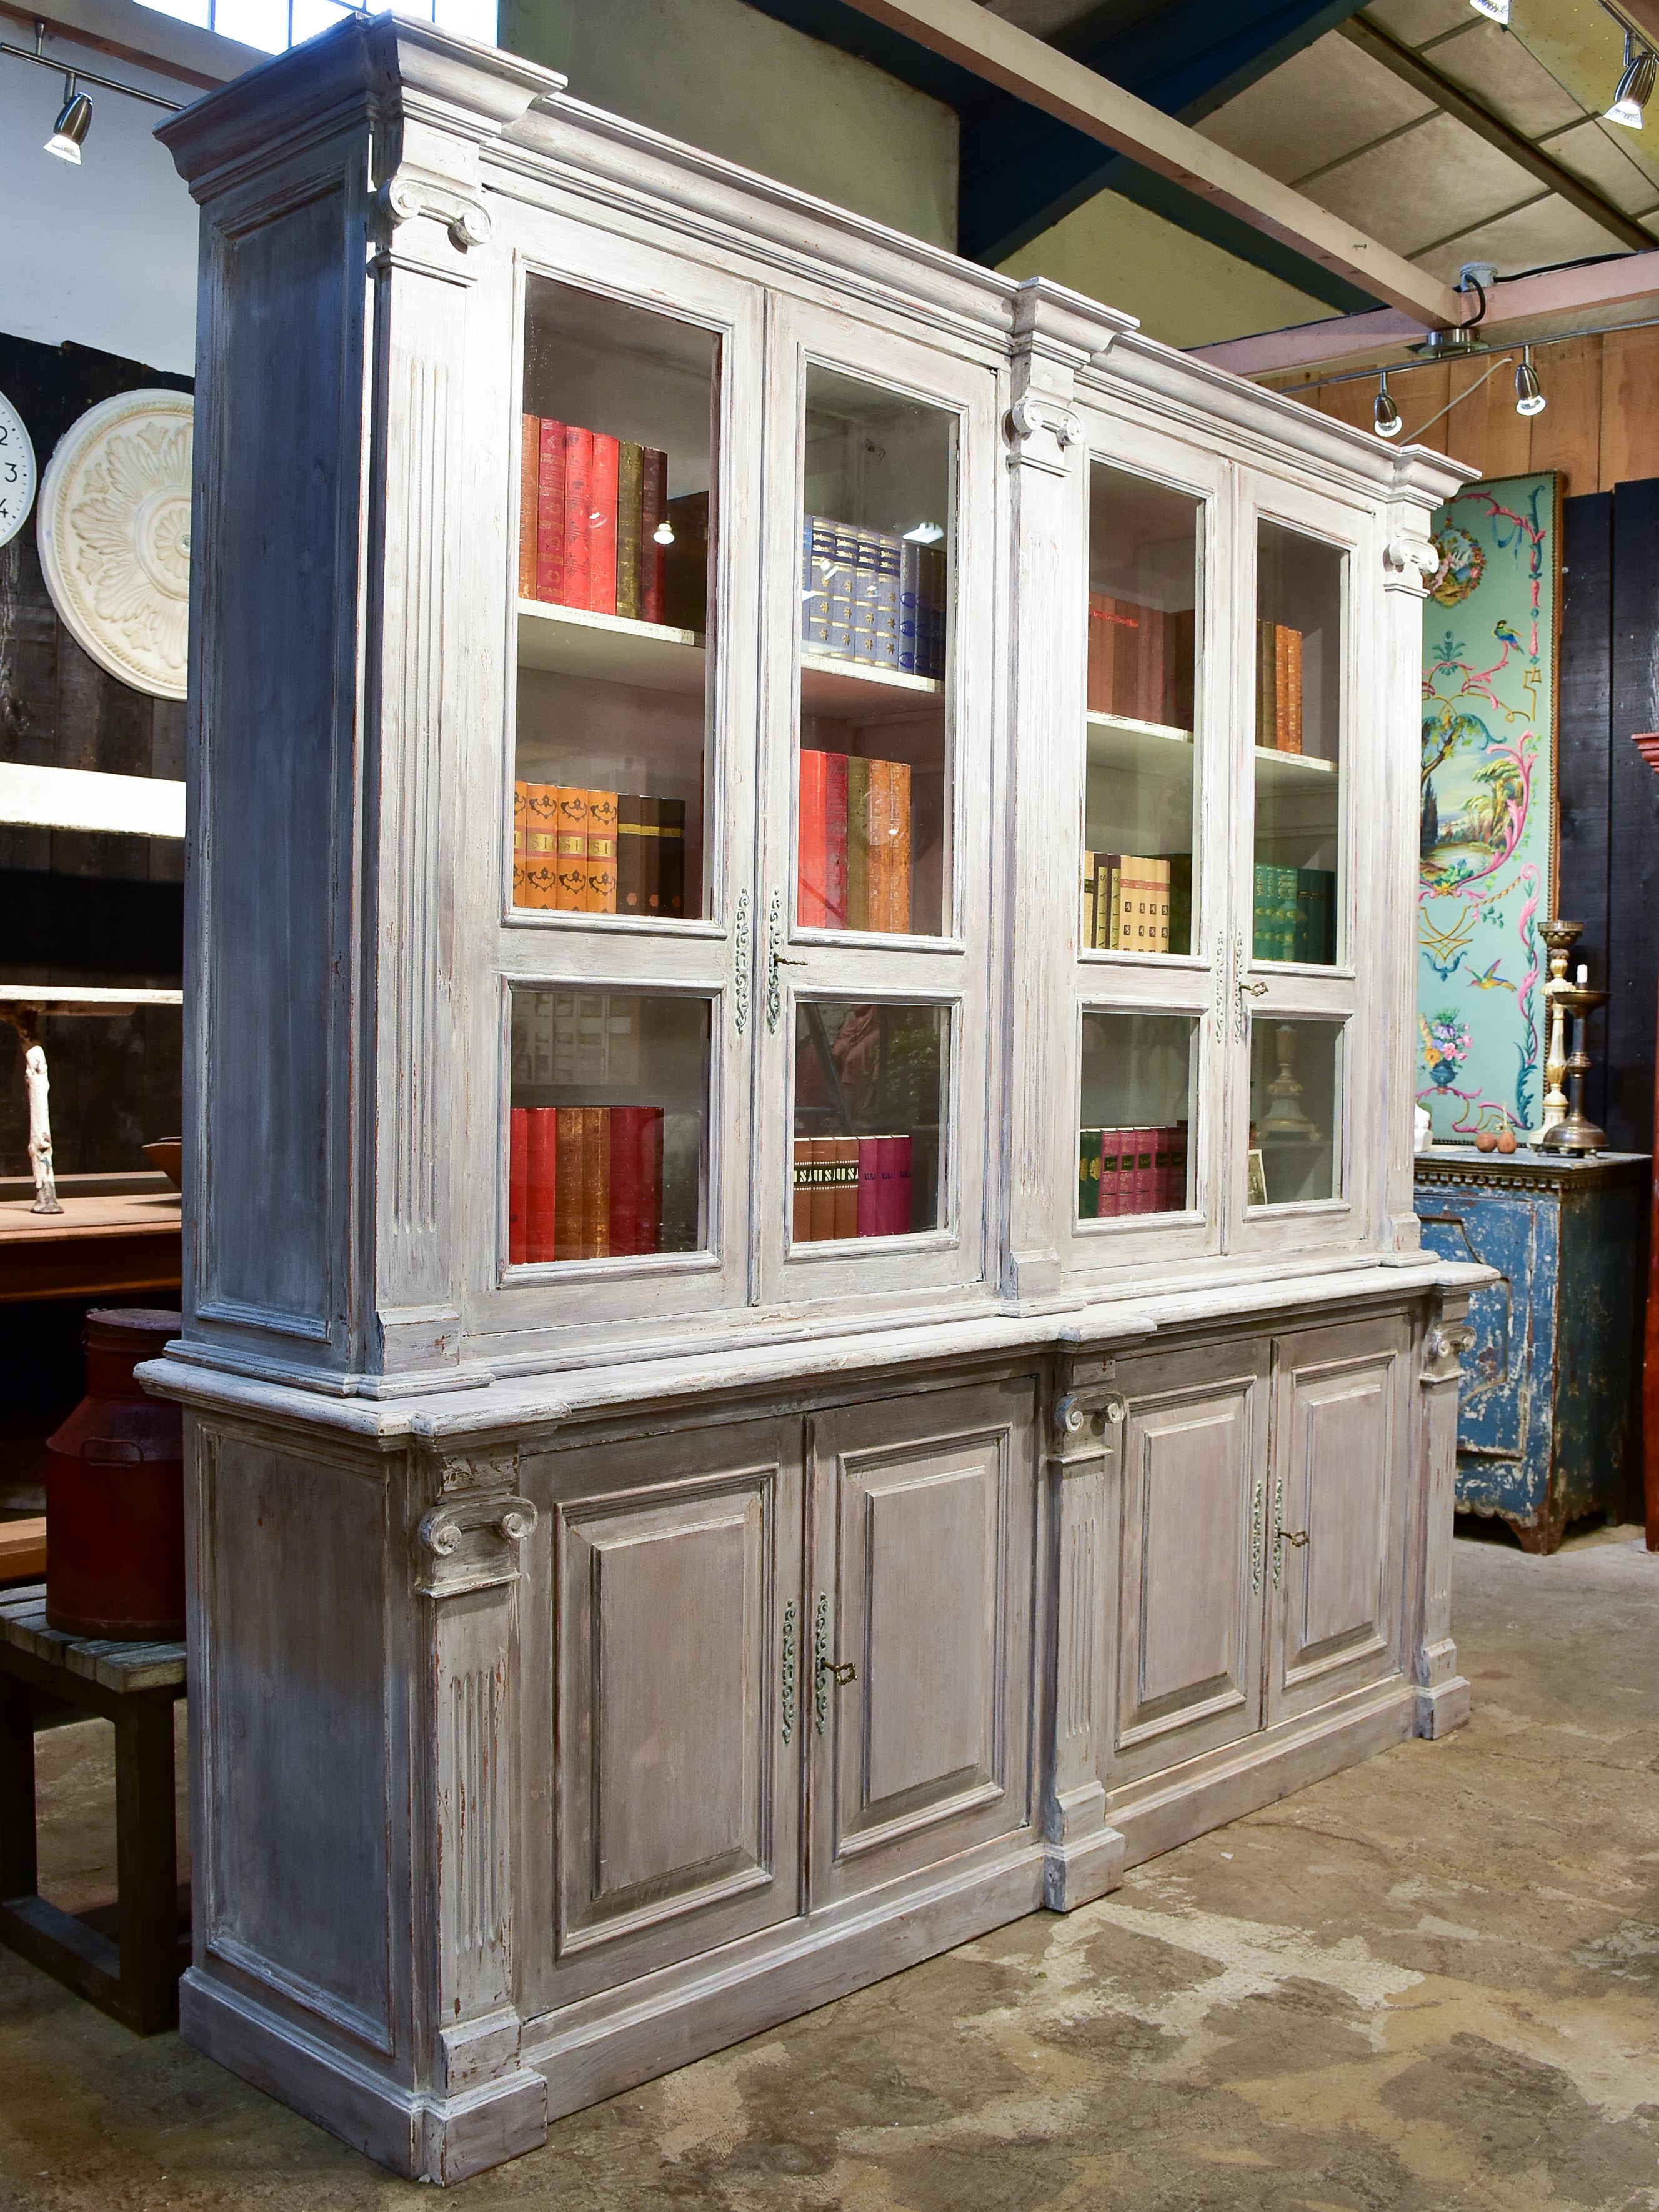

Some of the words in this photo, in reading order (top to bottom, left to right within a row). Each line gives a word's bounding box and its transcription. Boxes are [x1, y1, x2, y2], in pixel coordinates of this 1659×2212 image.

[0, 426, 8, 446] 2
[4, 462, 18, 482] 3
[0, 498, 9, 518] 4
